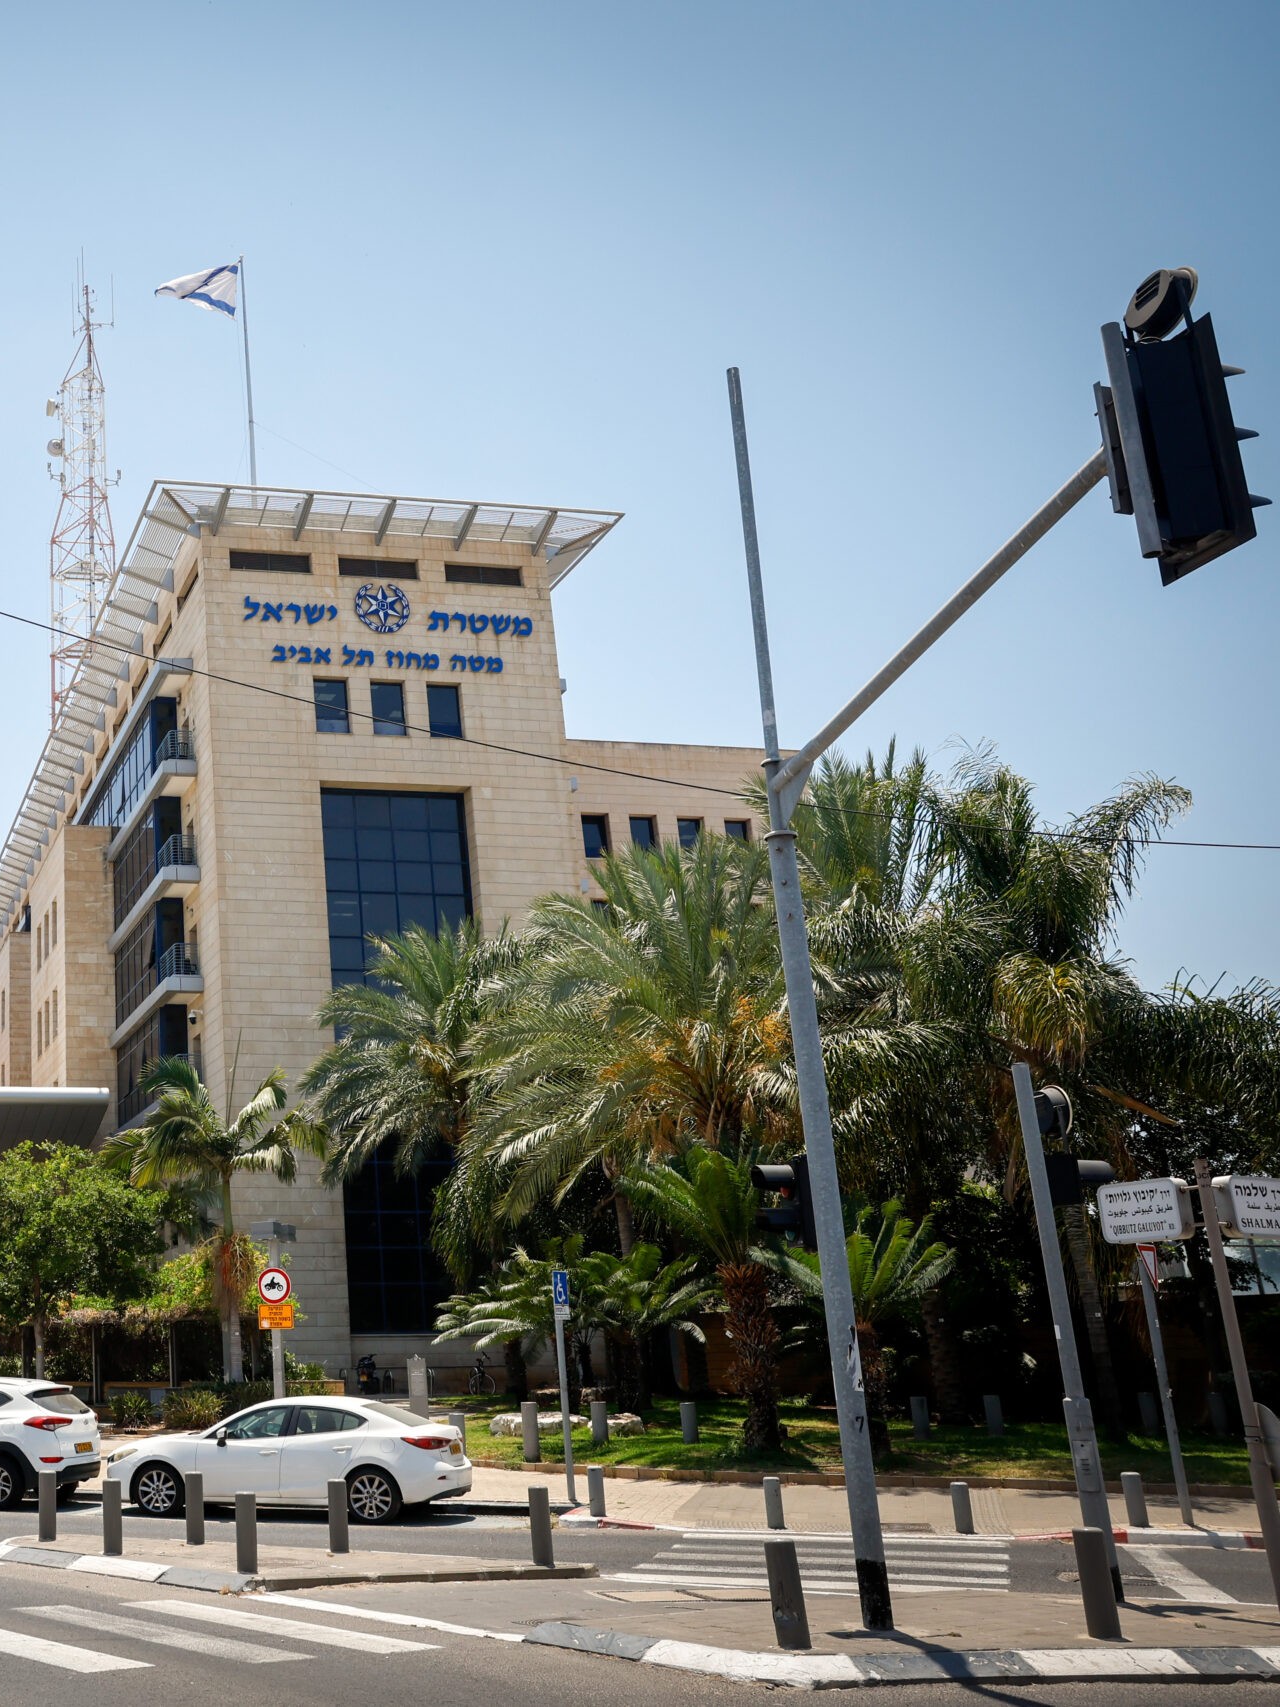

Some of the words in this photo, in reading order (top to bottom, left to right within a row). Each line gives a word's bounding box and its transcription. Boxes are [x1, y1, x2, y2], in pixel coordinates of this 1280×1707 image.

[243, 595, 338, 625] ישראל
[427, 610, 533, 637] משטרת
[271, 644, 332, 665] אביב
[342, 644, 374, 667] תל
[386, 650, 440, 670] מחוז
[450, 653, 503, 673] מטה
[1234, 1182, 1268, 1197] שלמה
[1155, 1204, 1173, 1214] طريق
[1241, 1218, 1280, 1229] SHALMA
